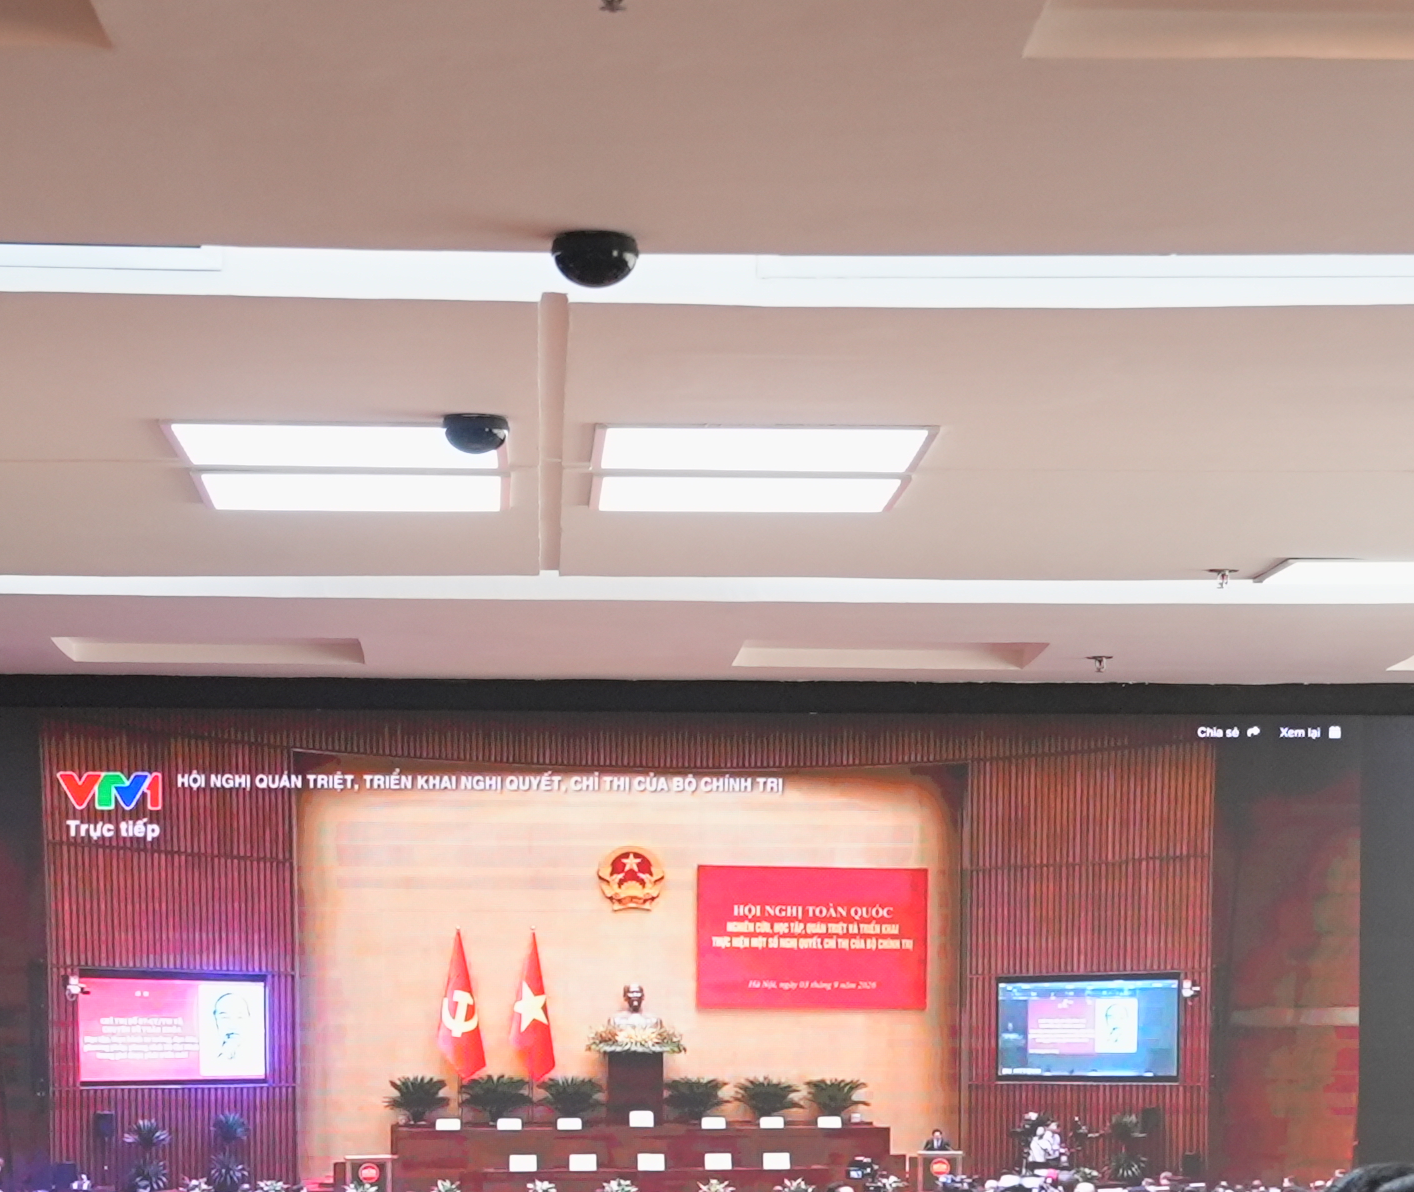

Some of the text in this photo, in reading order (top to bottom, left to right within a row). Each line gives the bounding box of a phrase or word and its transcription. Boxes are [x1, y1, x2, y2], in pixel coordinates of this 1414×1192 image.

[1197, 726, 1239, 738] Chia sẻ
[1279, 726, 1321, 740] Xem lại
[56, 771, 162, 810] VTV1
[177, 768, 783, 795] HỘI NGHỊ QUÁN TRIỆT, TRIỂN KHAI NGHỊ QUYẾT, CHỈ THỊ CỦA BỘ CHÍNH TRỊ
[66, 816, 160, 840] Trực tiếp
[733, 903, 893, 920] HỘI NGHỊ TOÀN QUỐC
